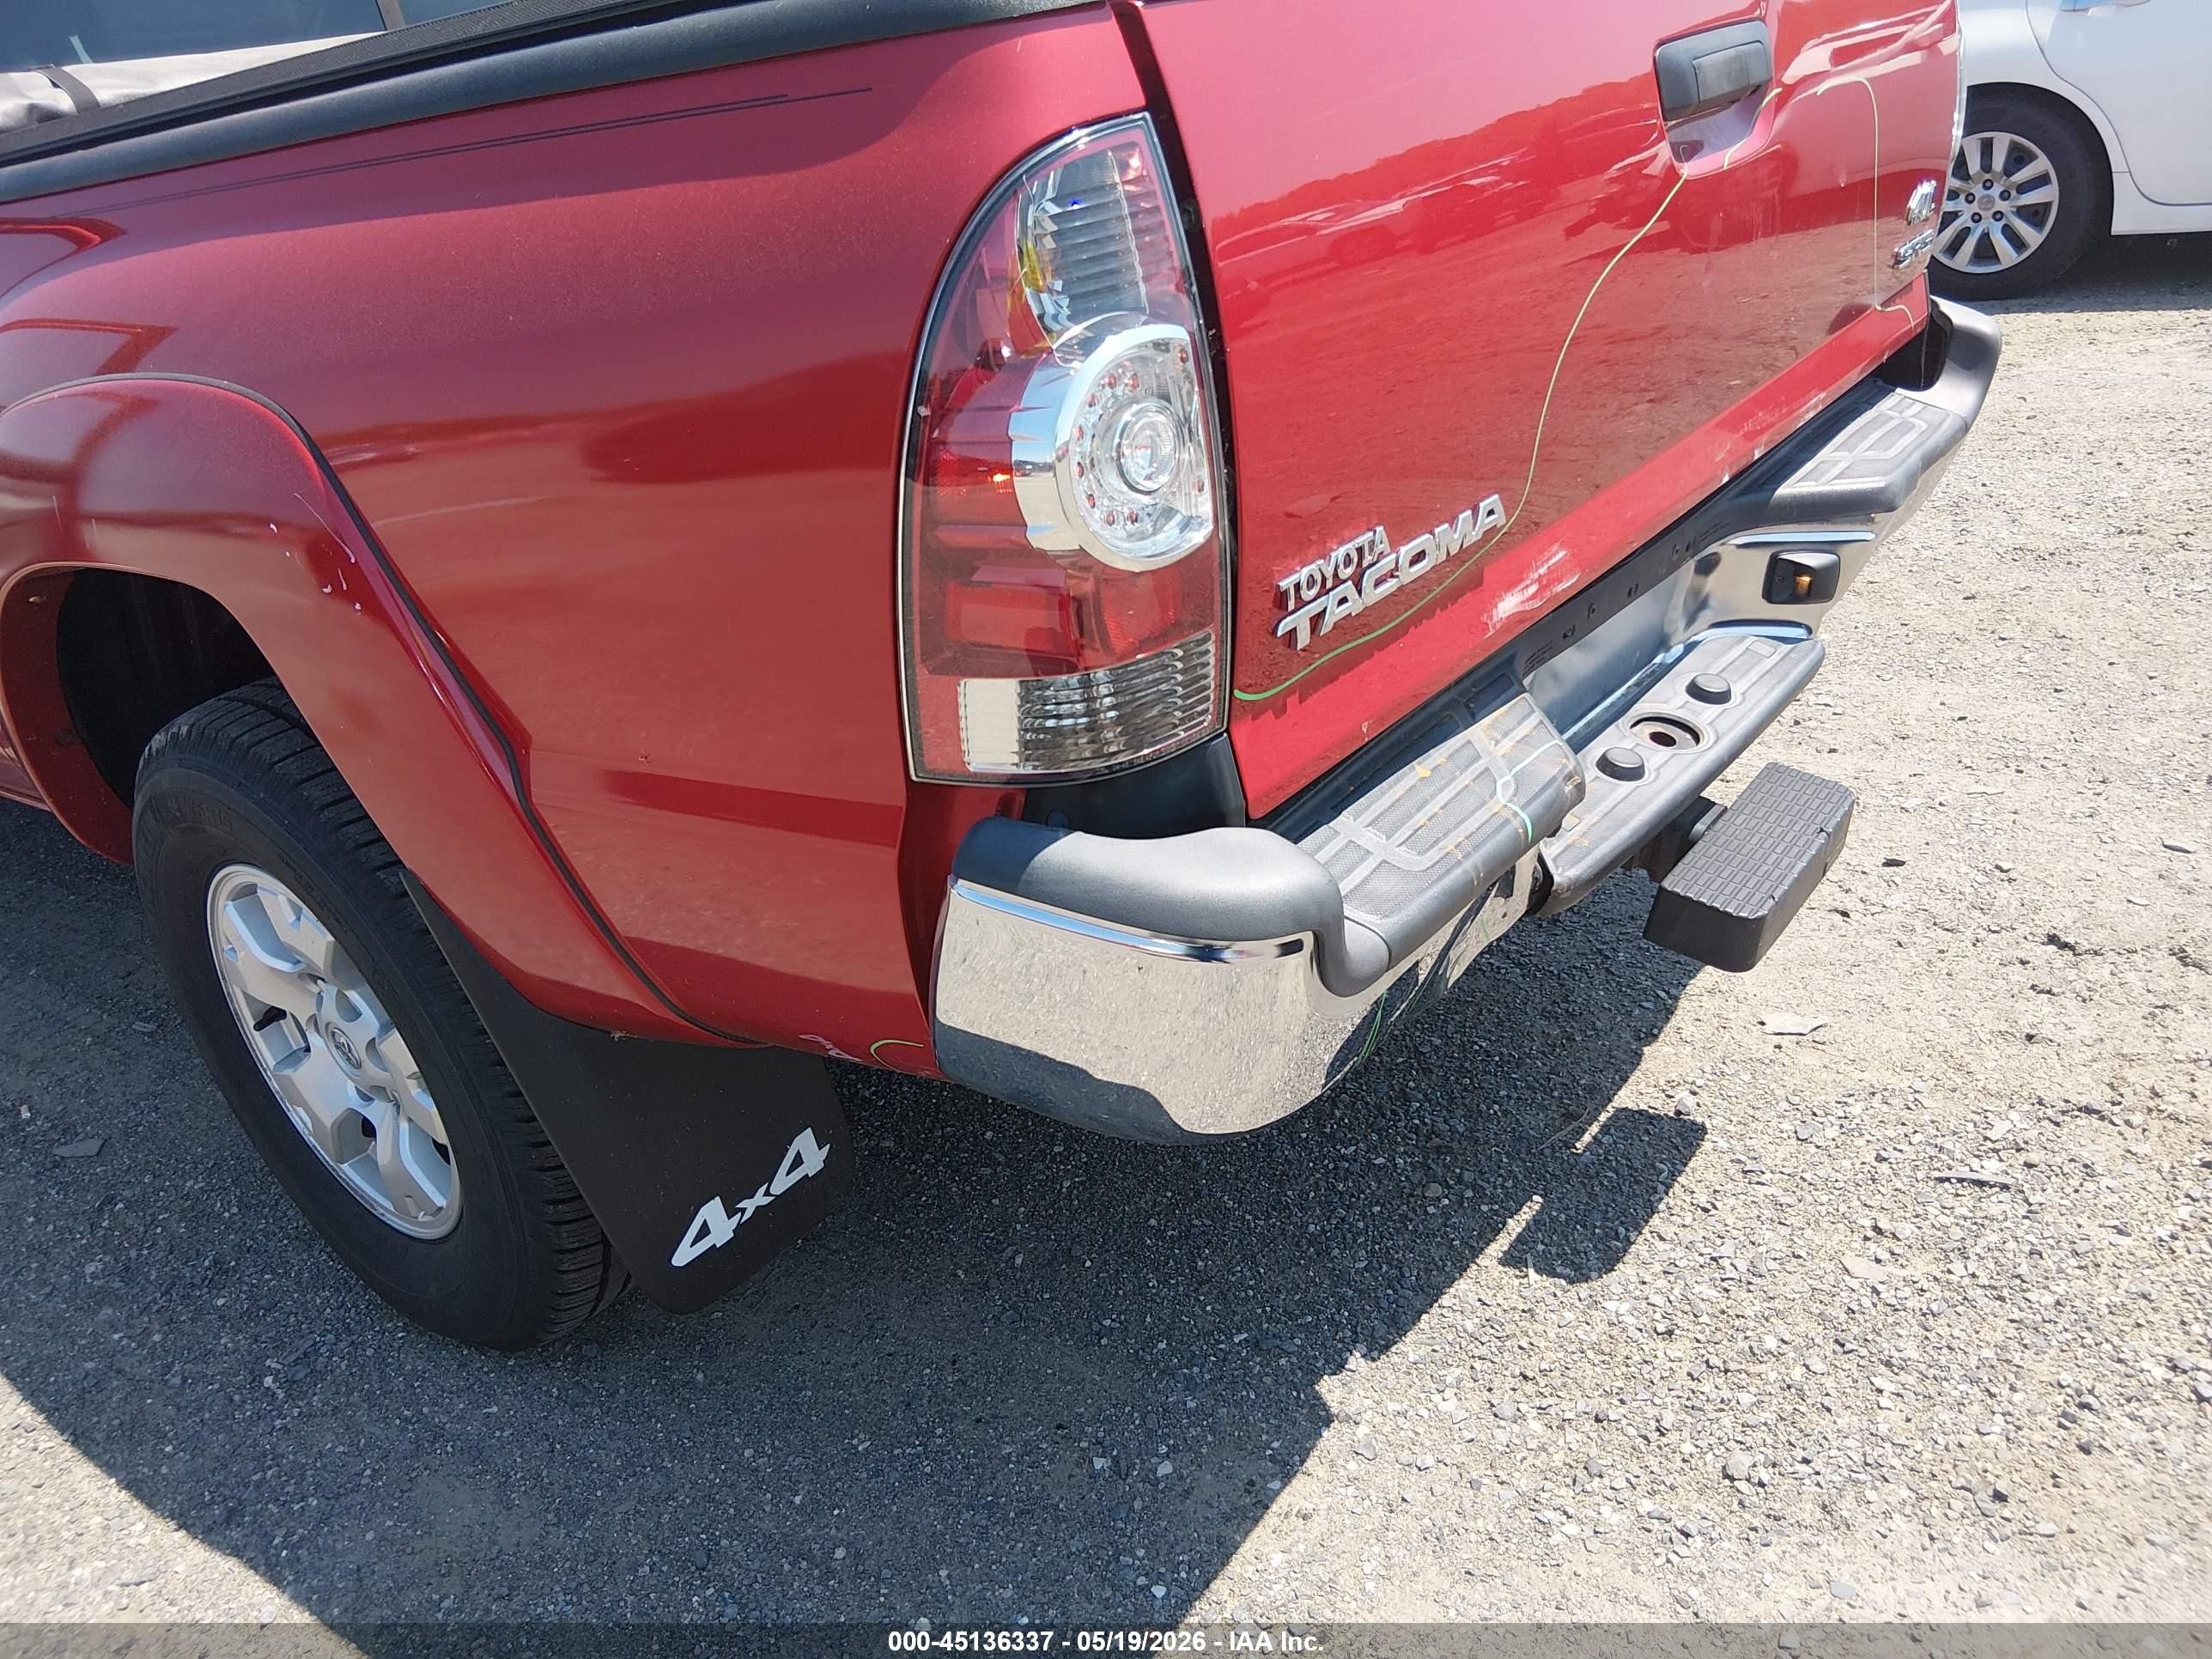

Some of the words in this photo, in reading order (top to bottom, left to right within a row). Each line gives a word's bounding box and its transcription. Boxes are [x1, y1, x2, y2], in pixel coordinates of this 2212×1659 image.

[1275, 493, 1506, 652] TACOMA
[1277, 525, 1391, 613] TOYOTA
[671, 1126, 831, 1267] 4x4
